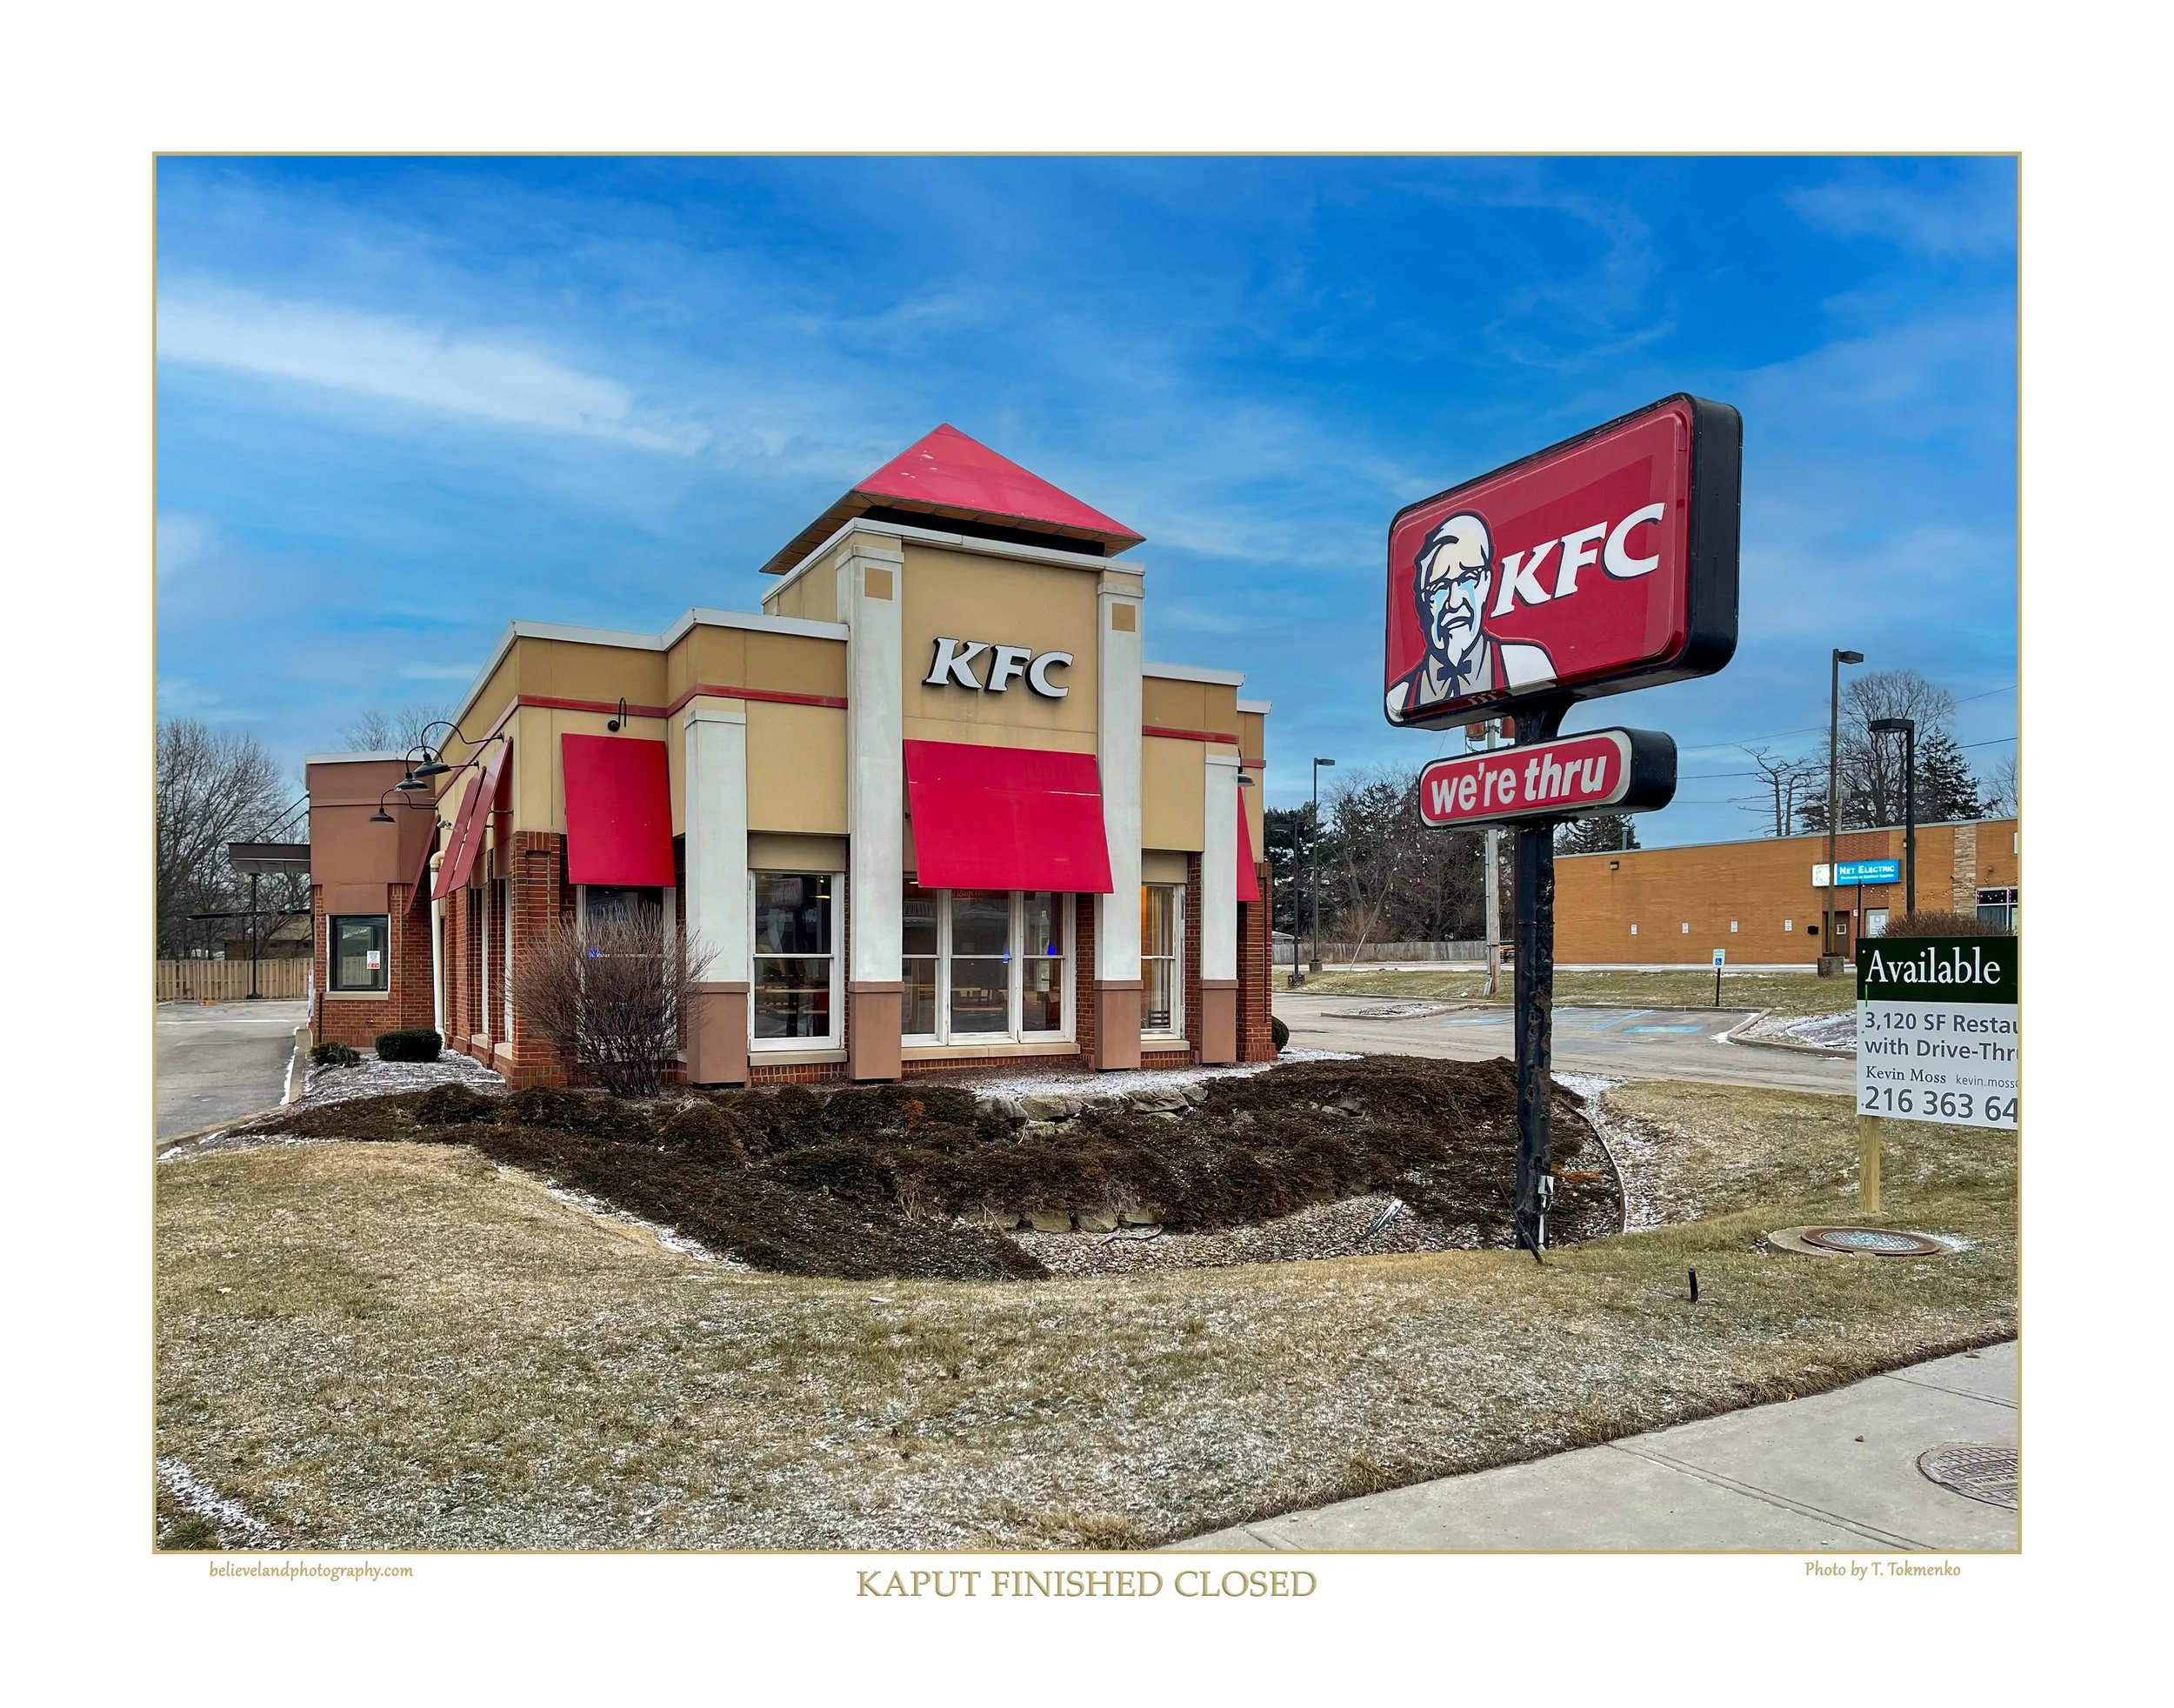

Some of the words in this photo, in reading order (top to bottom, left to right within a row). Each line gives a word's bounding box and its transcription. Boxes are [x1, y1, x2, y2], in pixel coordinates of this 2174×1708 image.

[1490, 503, 1665, 618] KFC
[922, 637, 1074, 697] KFC
[1431, 762, 1516, 815] we're
[1524, 752, 1607, 800] thru
[1839, 866, 1856, 875] NET
[1857, 865, 1895, 874] ELECTRIC
[1865, 946, 2001, 984] Available
[1864, 1011, 1917, 1031] 3,120
[1924, 1013, 1946, 1031] SF
[1864, 1037, 1909, 1056] with
[1917, 1039, 2018, 1062] Drive-Thr
[1866, 1065, 1905, 1081] Kevin
[1910, 1069, 1946, 1084] Moss
[1956, 1074, 2018, 1089] kevin.moss
[1864, 1086, 1913, 1113] 216
[1923, 1091, 1974, 1119] 363
[1984, 1096, 2018, 1124] 64
